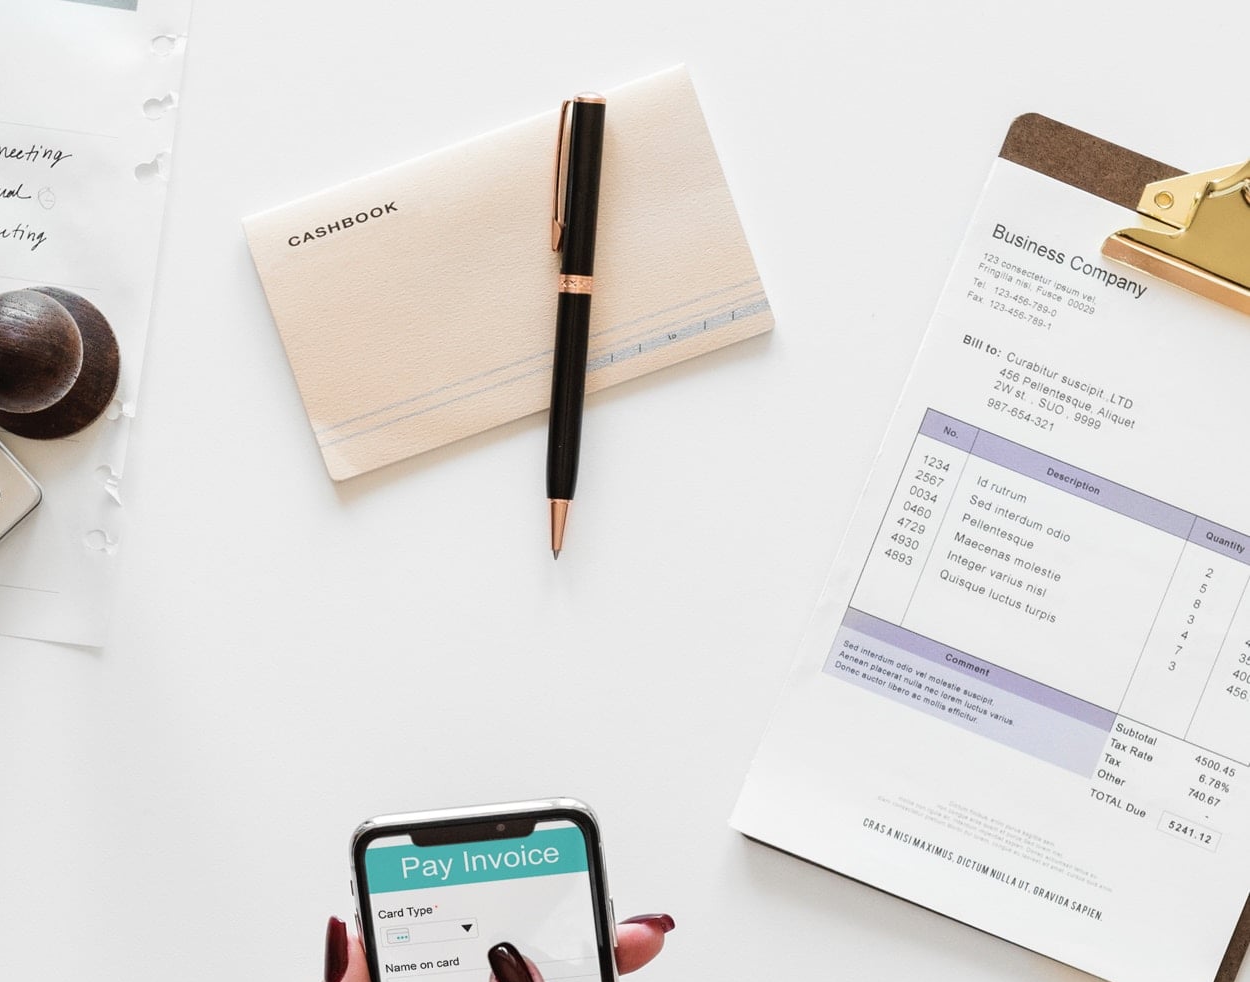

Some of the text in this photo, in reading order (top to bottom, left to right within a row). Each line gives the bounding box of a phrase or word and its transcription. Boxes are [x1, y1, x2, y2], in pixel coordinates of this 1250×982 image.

[287, 200, 398, 247] CASHBOOK
[991, 222, 1148, 300] Business Company
[983, 252, 1080, 297] 123 consectetur ipsum
[989, 299, 1052, 330] 123-456-789-1
[994, 286, 1057, 318] 123-456-789-0
[962, 333, 1059, 380] Bill to: Curabitur
[998, 367, 1020, 383] 456
[1095, 406, 1135, 429] Aliquet
[986, 397, 1054, 432] 987-654-321
[942, 425, 959, 439] No.
[923, 454, 950, 473] 1234
[914, 468, 945, 488] 2567
[1045, 466, 1100, 496] Description
[908, 484, 938, 504] 0034
[989, 482, 1027, 504] rutrum
[902, 500, 932, 519] 0460
[968, 493, 1071, 543] Sed interdum odio
[896, 516, 926, 535] 4729
[960, 512, 1034, 550] Pellentesque
[889, 532, 920, 551] 4930
[1205, 530, 1246, 554] Quantity
[883, 547, 913, 566] 4893
[953, 530, 1061, 582] Maecenas molestie
[944, 652, 990, 677] Comment
[1114, 722, 1158, 746] Subtotal
[1104, 752, 1121, 768] Tax
[1110, 736, 1153, 762] Tax Rate
[1194, 754, 1236, 777] 4500.45
[1197, 773, 1230, 793] 6.78%
[1090, 787, 1146, 818] TOTAL Due
[1187, 786, 1221, 807] 740.67
[1167, 819, 1212, 844] 5241.12
[400, 844, 560, 881] Pay Invoice
[862, 817, 886, 834] CRAS
[885, 826, 893, 837] A
[892, 829, 913, 844] NISI
[955, 854, 990, 875] DICTUM
[988, 867, 1017, 887] NULLA
[1032, 885, 1070, 908] GRAVIDA
[377, 905, 433, 920] Card Type
[384, 956, 460, 973] Name on card
